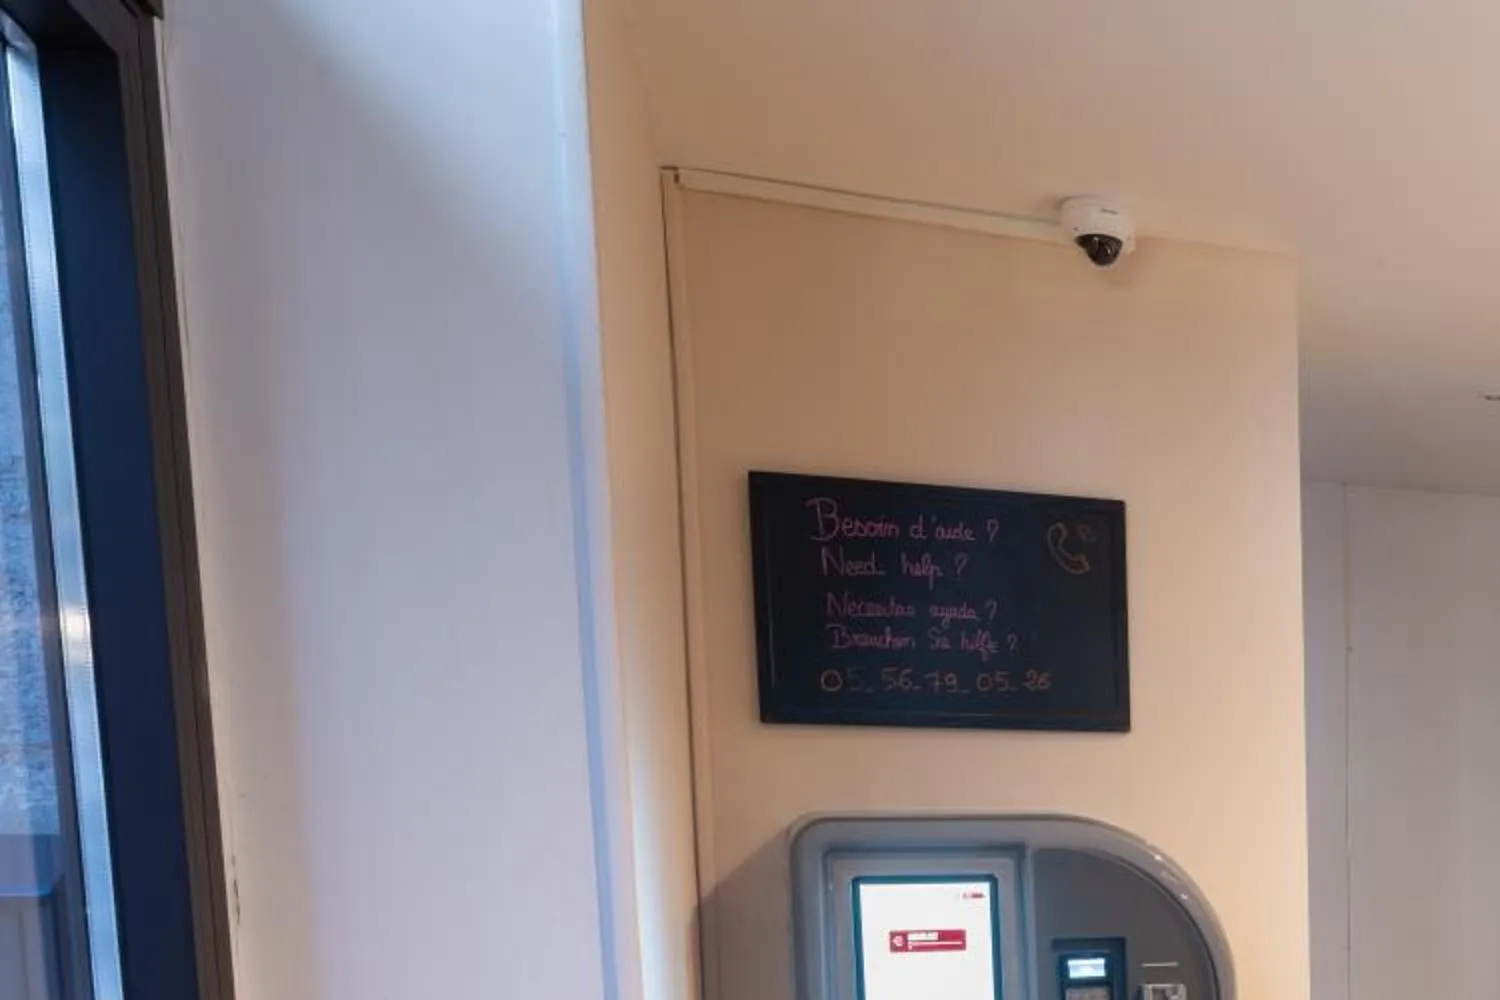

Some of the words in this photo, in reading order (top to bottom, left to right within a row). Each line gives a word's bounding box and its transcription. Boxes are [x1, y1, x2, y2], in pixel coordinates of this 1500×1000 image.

[805, 496, 900, 542] Besoin
[820, 546, 886, 577] Need
[901, 553, 944, 591] help
